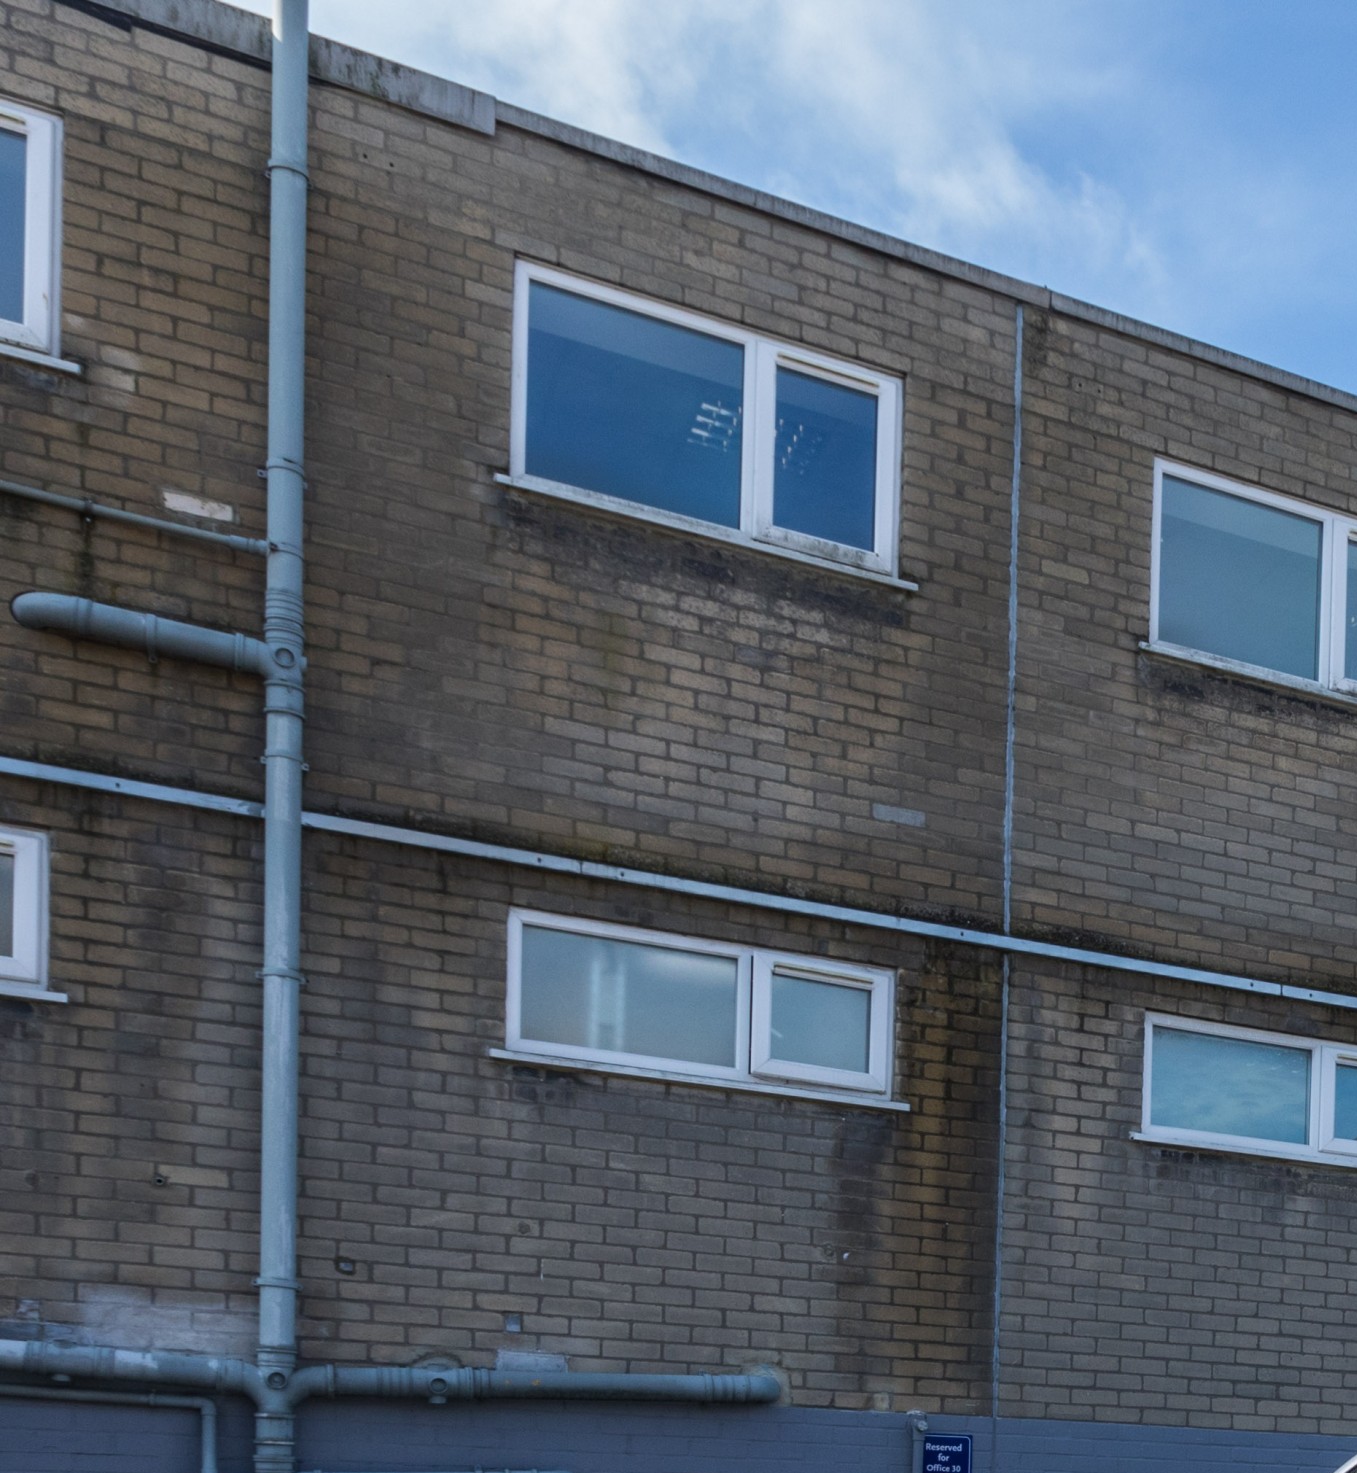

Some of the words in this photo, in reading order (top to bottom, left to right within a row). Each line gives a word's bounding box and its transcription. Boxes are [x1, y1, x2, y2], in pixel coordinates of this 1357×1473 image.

[925, 1443, 962, 1451] Reserved
[937, 1452, 950, 1461] for
[926, 1464, 950, 1472] Office
